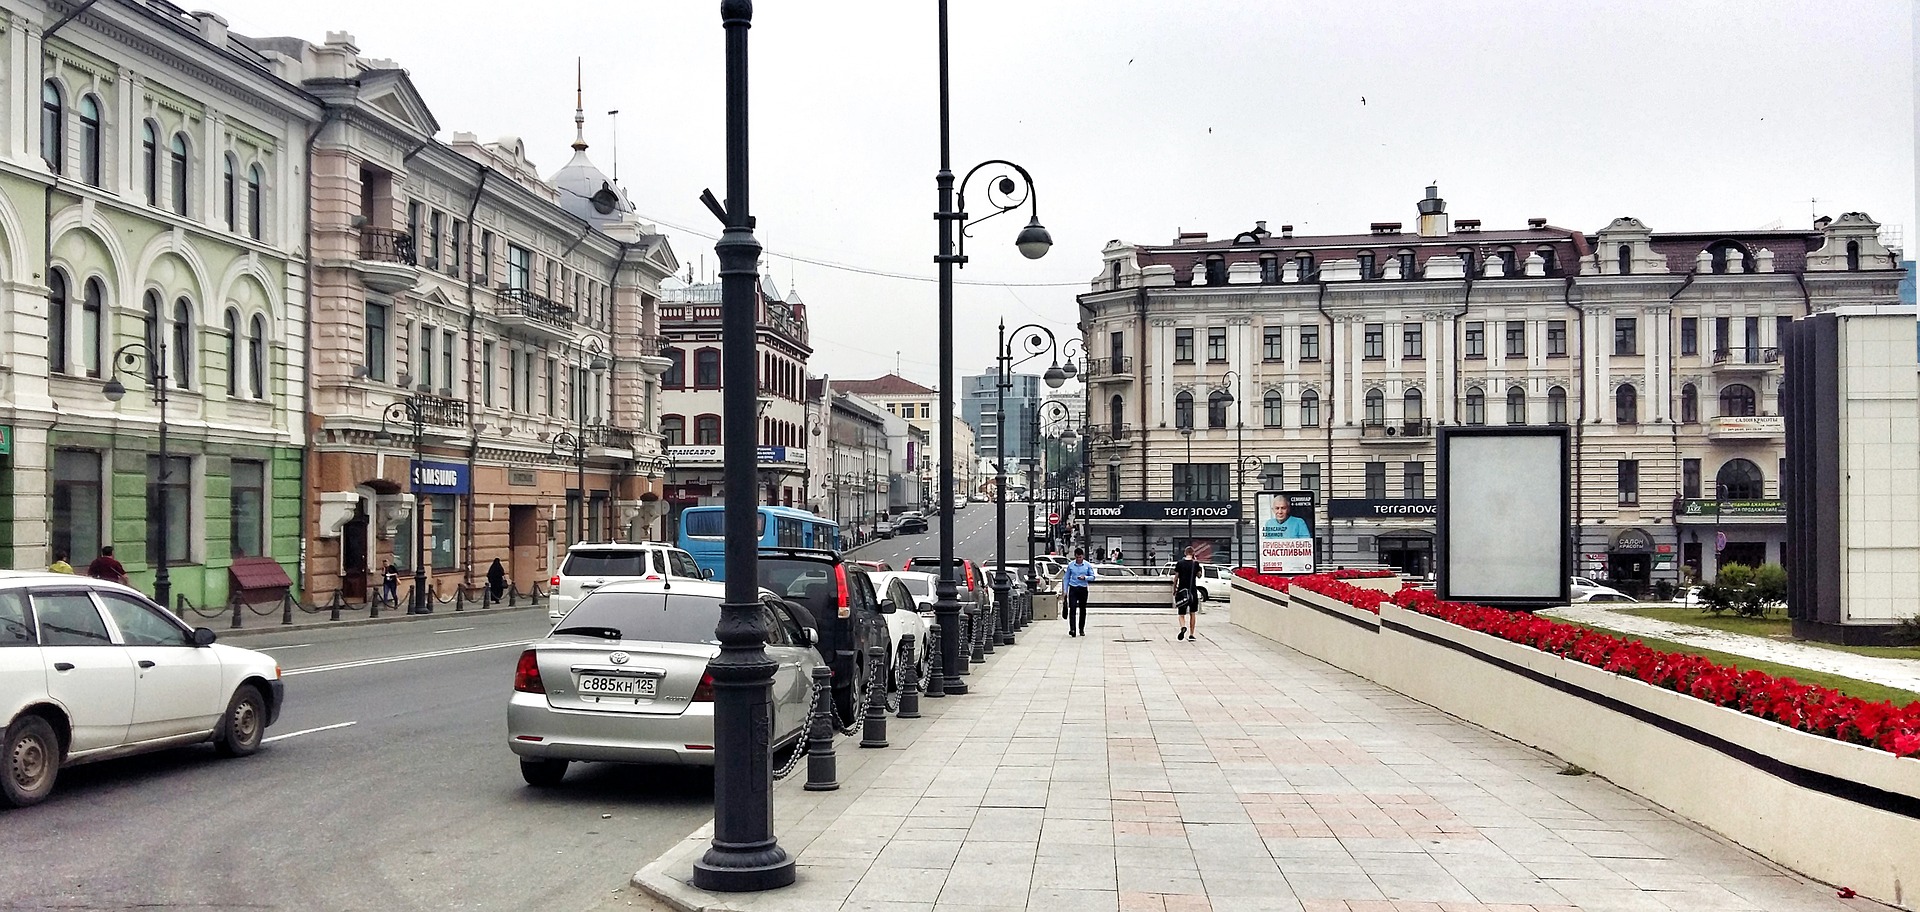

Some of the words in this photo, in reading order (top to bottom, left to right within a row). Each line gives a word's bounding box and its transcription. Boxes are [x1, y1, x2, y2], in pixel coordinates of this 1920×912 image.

[414, 467, 457, 486] SAMSUNG
[1262, 541, 1295, 549] ПРИВЫЧКА
[1262, 549, 1312, 557] СЧАСТЛИВЫМ
[635, 679, 653, 690] 125
